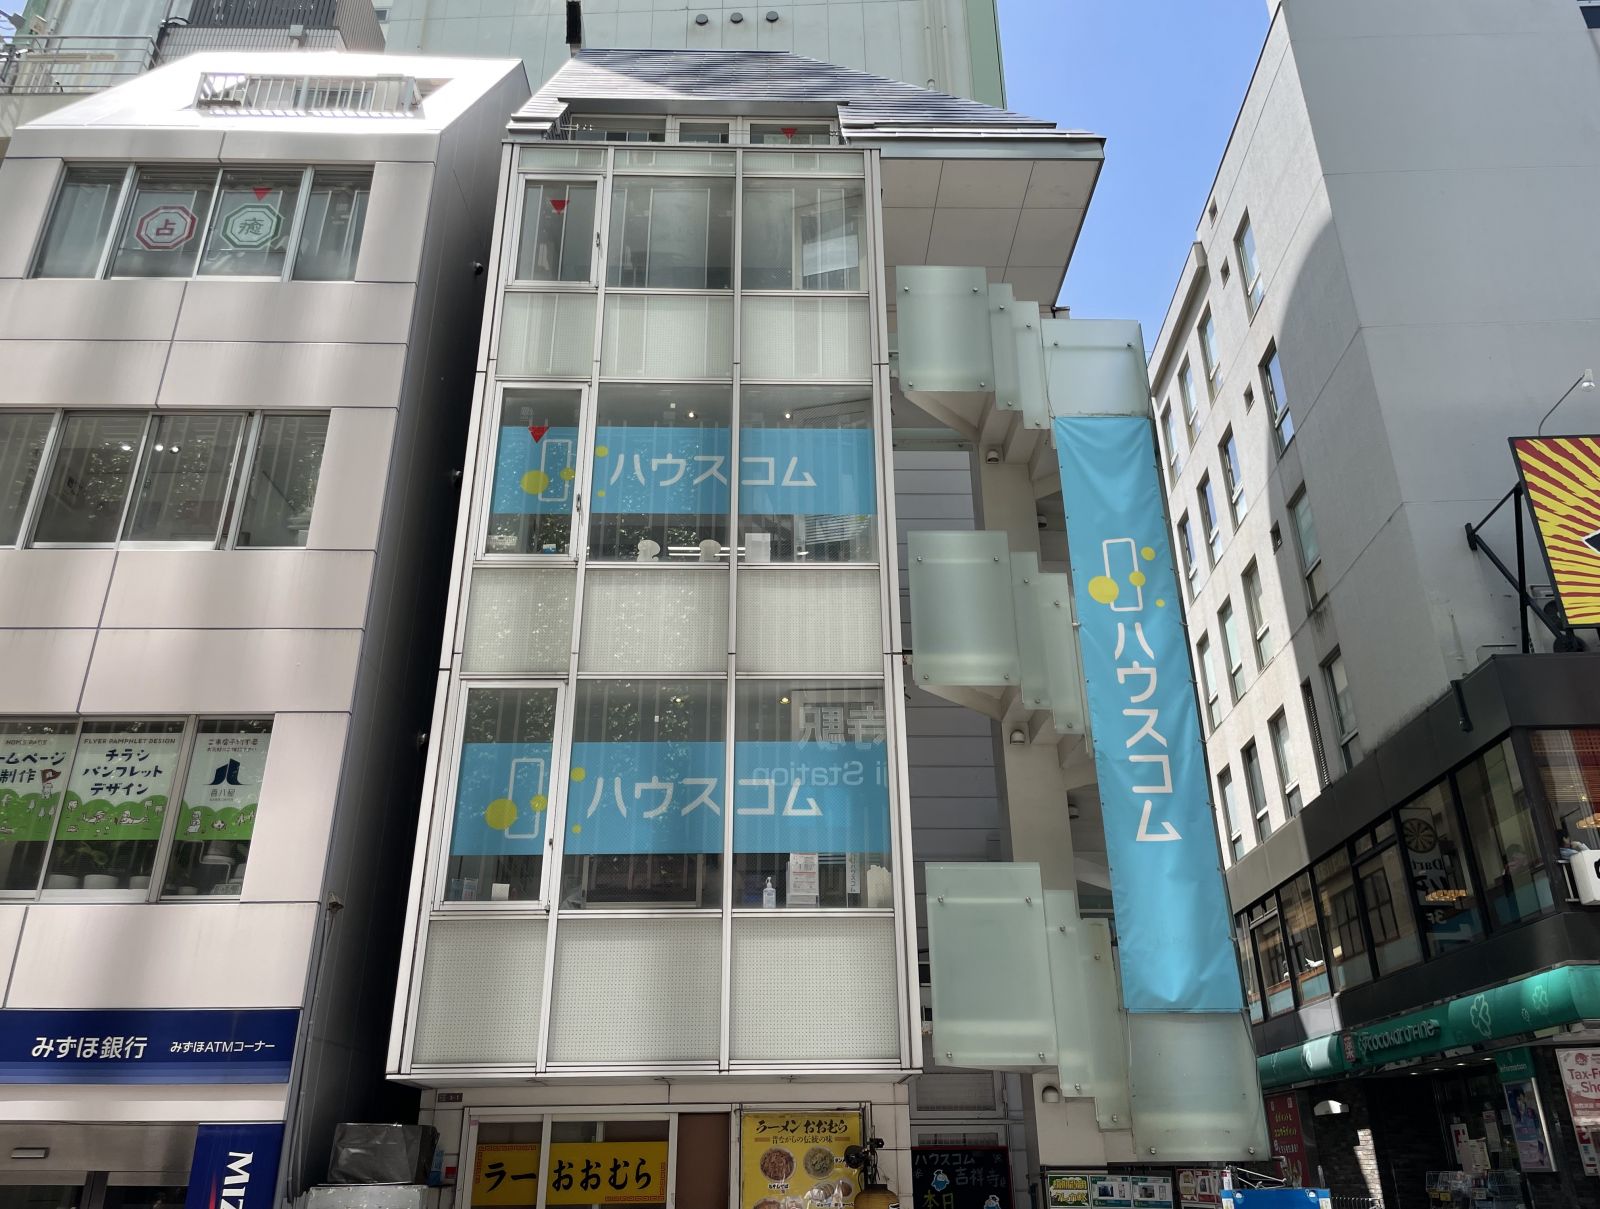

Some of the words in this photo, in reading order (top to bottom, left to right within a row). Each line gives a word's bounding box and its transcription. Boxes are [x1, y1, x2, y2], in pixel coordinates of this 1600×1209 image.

[155, 218, 177, 237] 占
[609, 453, 818, 488] ハウスコム
[1114, 621, 1183, 843] ハウスコム
[105, 748, 150, 762] チラシ
[0, 768, 37, 784] 制作
[82, 765, 163, 778] パンフレット
[90, 782, 149, 796] デザイン
[586, 774, 824, 820] ハウスコム
[31, 1036, 148, 1060] みずほ銀行
[169, 1040, 276, 1054] みずほATMコーナー
[755, 1119, 801, 1134] ラーメン
[803, 1119, 848, 1134] おおむら
[772, 1135, 833, 1145] 昔ながらの伝統の味
[914, 1152, 976, 1166] ハウスコム
[484, 1161, 537, 1194] ラー
[551, 1157, 652, 1192] おおむら
